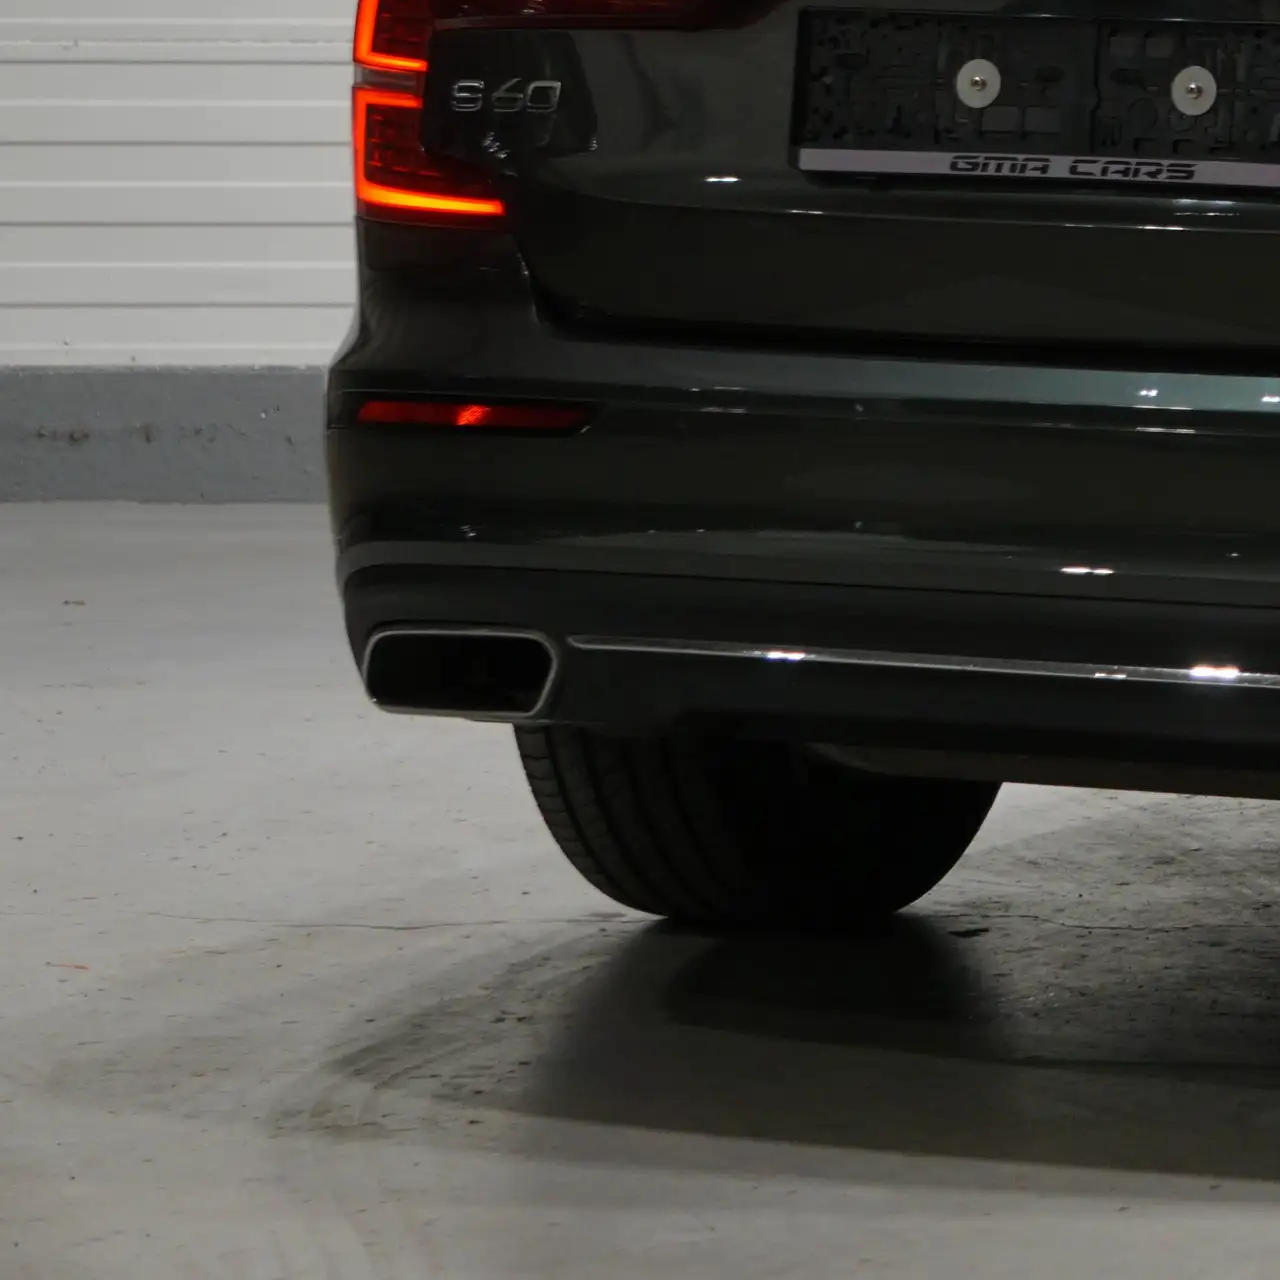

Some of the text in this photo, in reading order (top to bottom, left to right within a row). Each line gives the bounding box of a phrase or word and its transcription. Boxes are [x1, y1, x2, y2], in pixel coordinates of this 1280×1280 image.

[451, 77, 562, 112] S60
[949, 155, 1199, 181] GMA CARS
